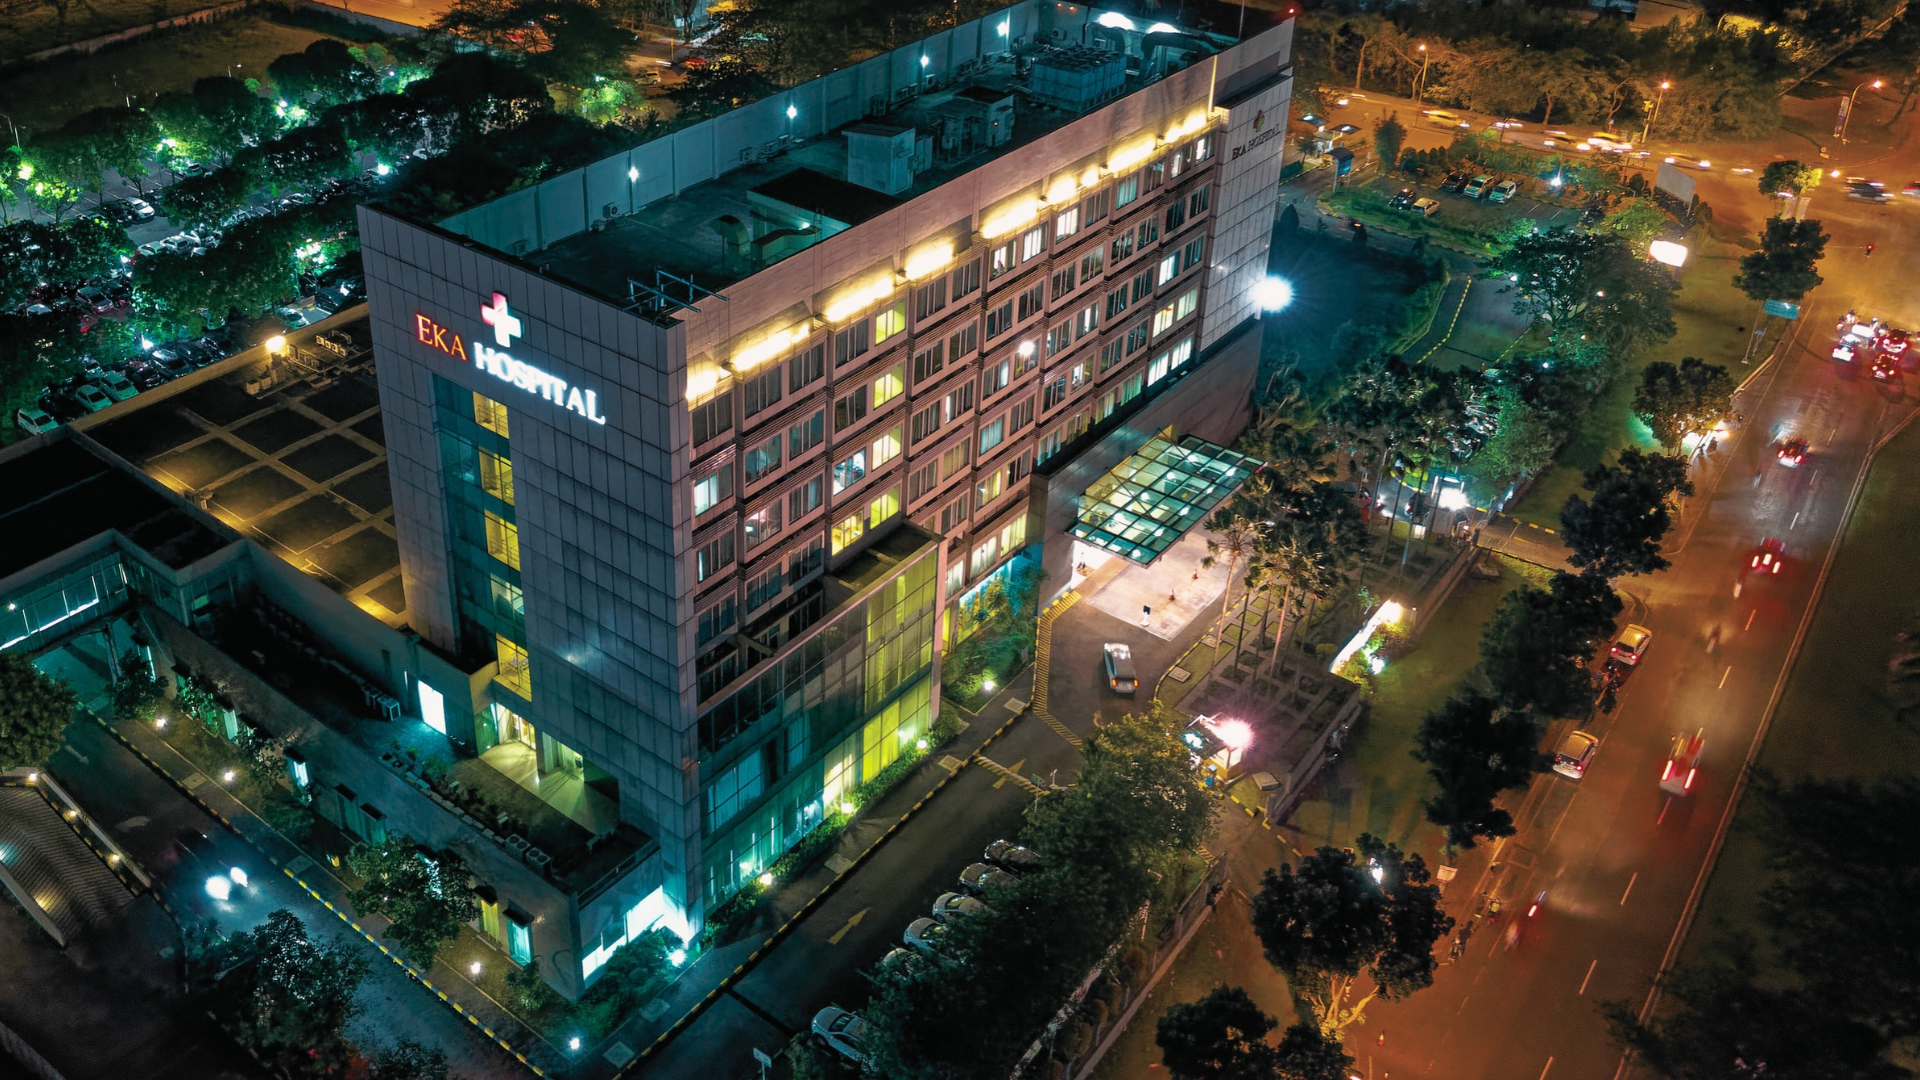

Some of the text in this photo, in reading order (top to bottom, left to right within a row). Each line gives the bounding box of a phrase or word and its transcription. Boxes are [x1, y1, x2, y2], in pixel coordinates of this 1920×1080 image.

[1248, 124, 1280, 151] HOSPITAL
[415, 313, 606, 425] EKA HOSPITAL
